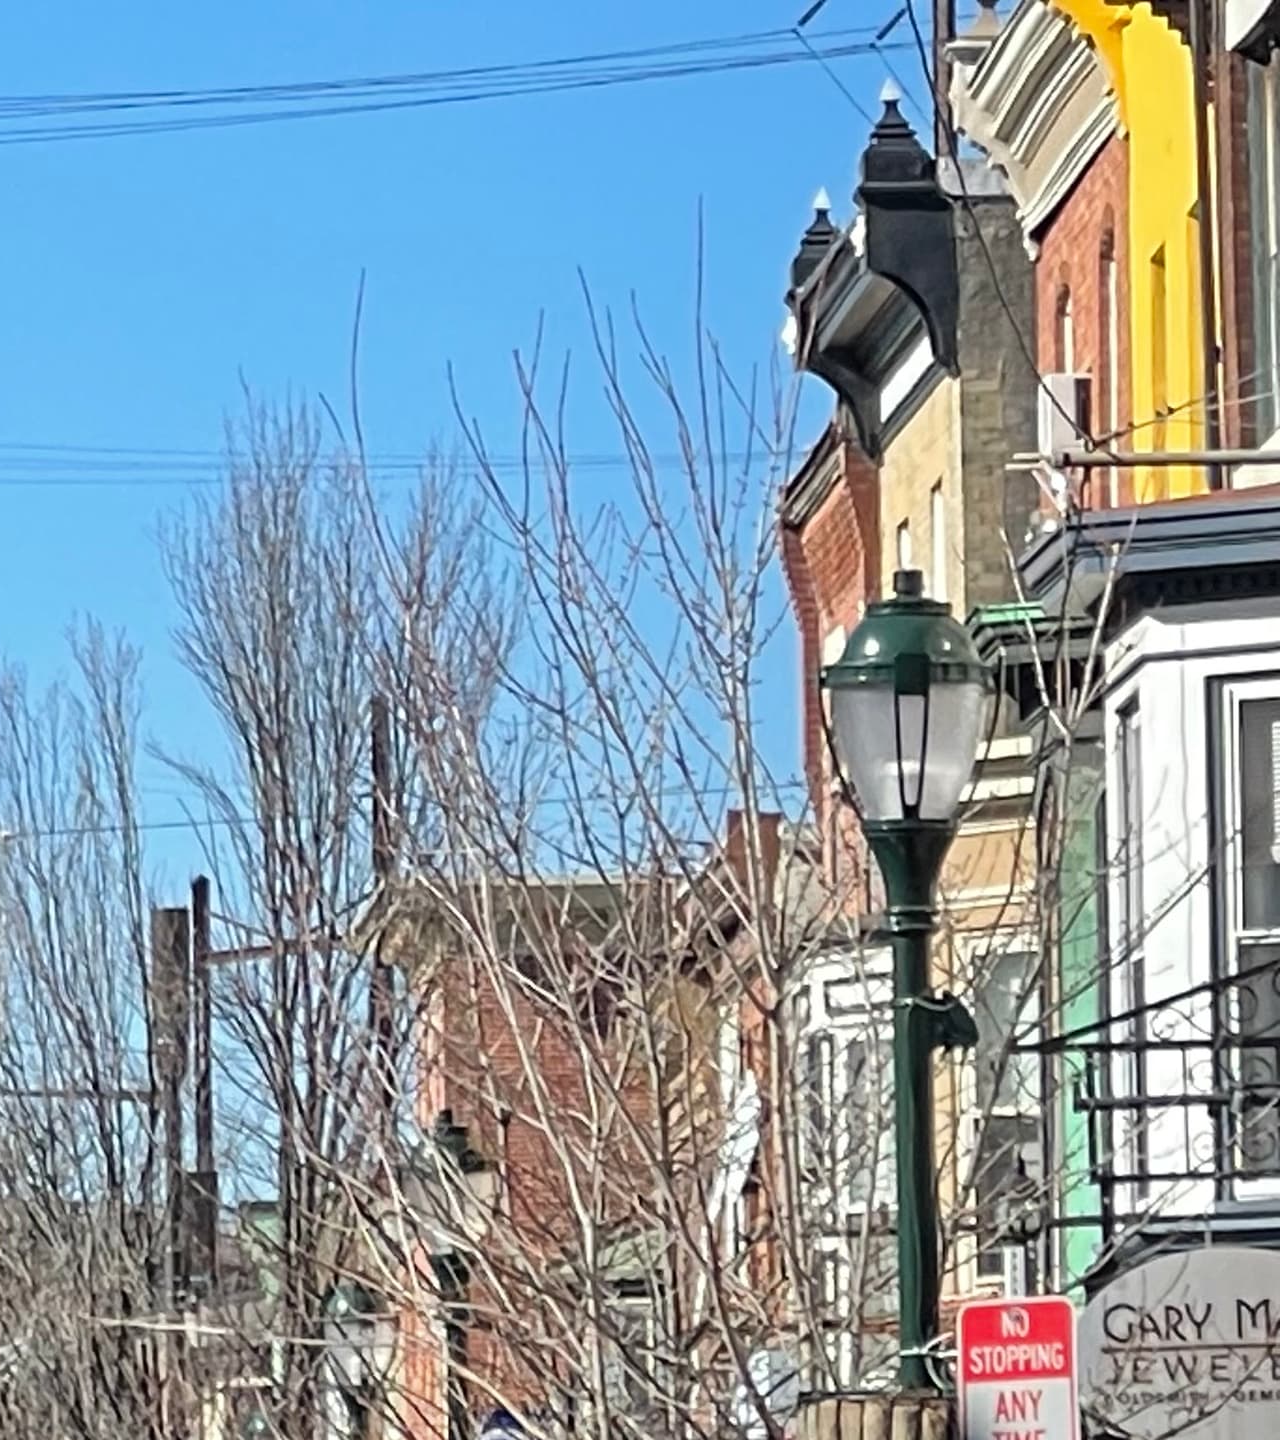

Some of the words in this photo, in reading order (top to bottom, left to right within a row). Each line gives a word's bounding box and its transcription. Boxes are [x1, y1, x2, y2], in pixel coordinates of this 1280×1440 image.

[1000, 1307, 1030, 1338] NO
[1103, 1301, 1212, 1343] GARY
[969, 1343, 1065, 1375] STOPPING
[994, 1390, 1043, 1424] ANY
